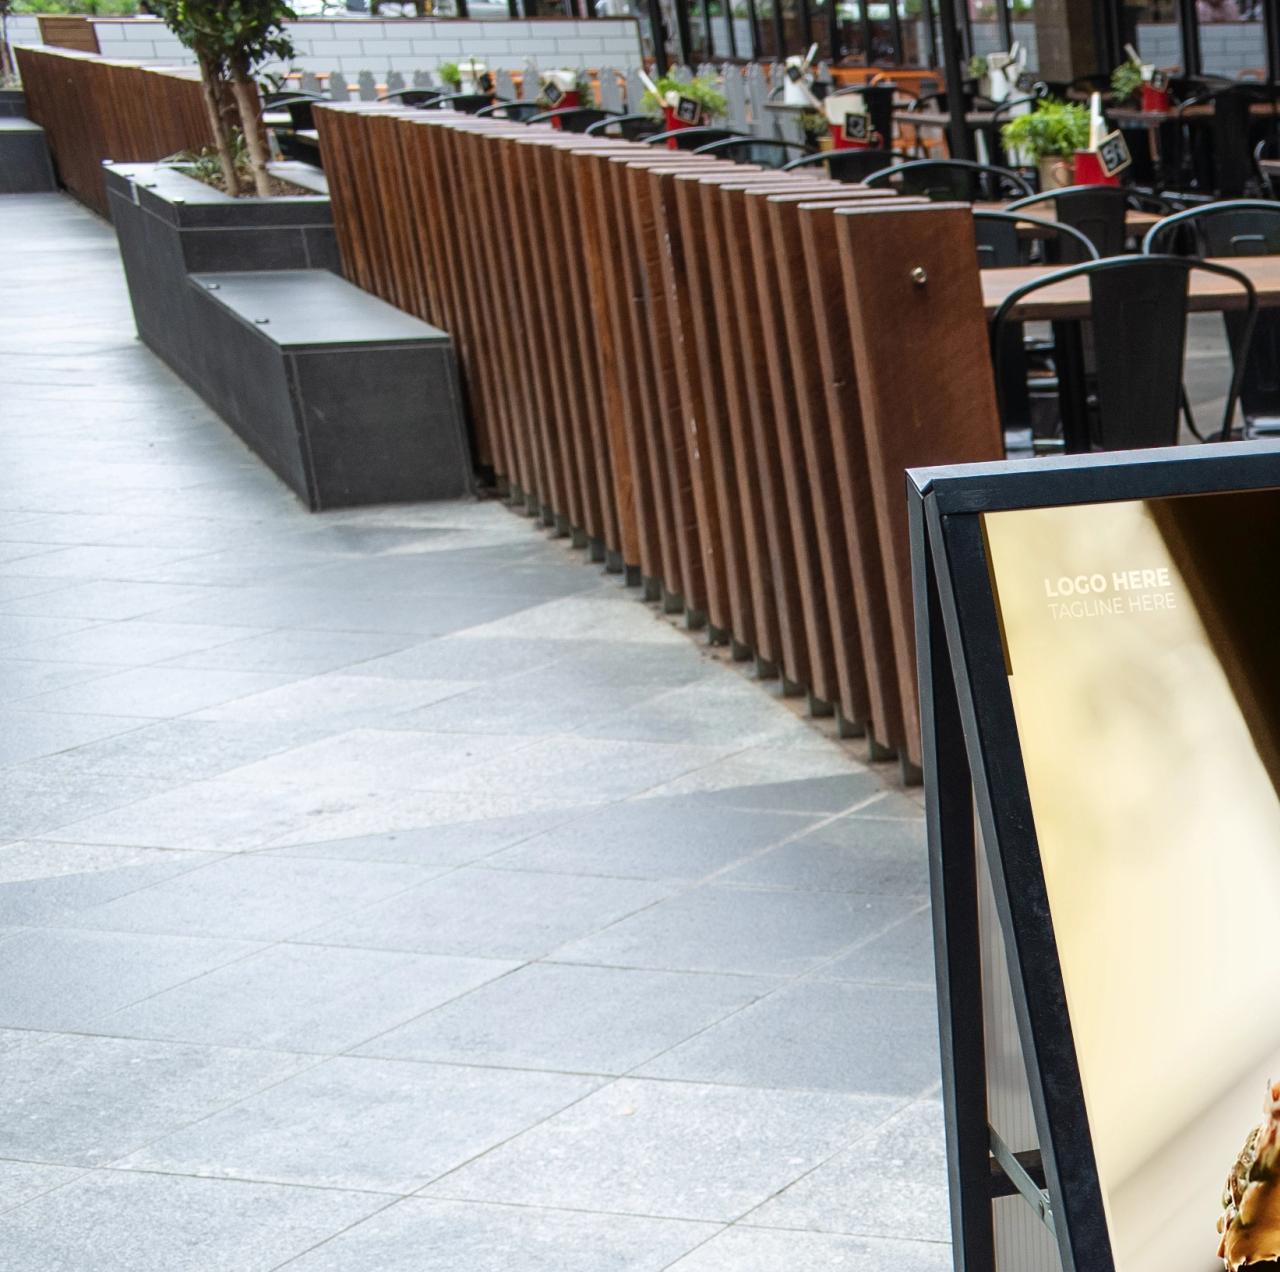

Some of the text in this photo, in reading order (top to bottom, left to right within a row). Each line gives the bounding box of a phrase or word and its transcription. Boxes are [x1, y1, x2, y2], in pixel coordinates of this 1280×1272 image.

[1044, 568, 1171, 598] LOGO HERE
[1048, 592, 1177, 621] TAGLINE HERE
